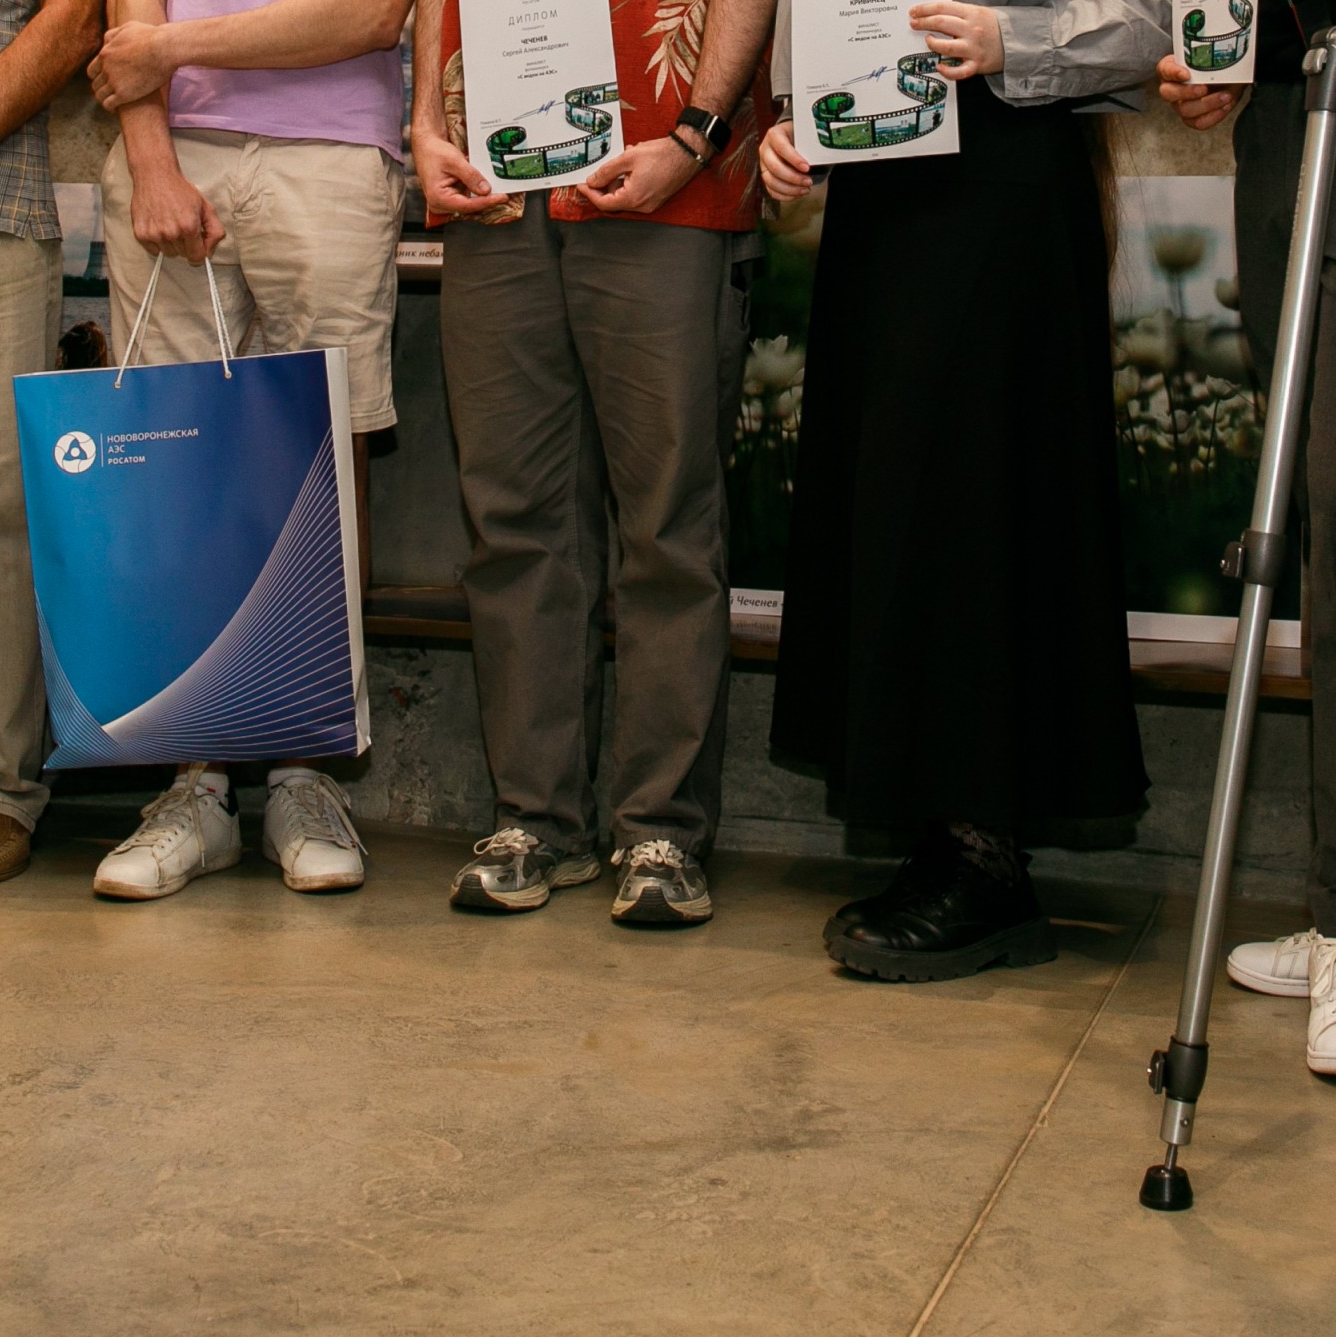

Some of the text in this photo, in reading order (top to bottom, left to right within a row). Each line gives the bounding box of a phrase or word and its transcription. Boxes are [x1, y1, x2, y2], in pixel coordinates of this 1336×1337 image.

[508, 9, 558, 27] ДИПЛОМ
[520, 35, 549, 45] ЧЕЧЕНЕВ
[502, 48, 523, 57] Сергей
[107, 428, 199, 444] НОВОВОРОНЕЖСКАЯ
[107, 445, 126, 454] АЭС
[107, 456, 146, 465] РОСАТОМ
[736, 595, 779, 608] Чеченев
